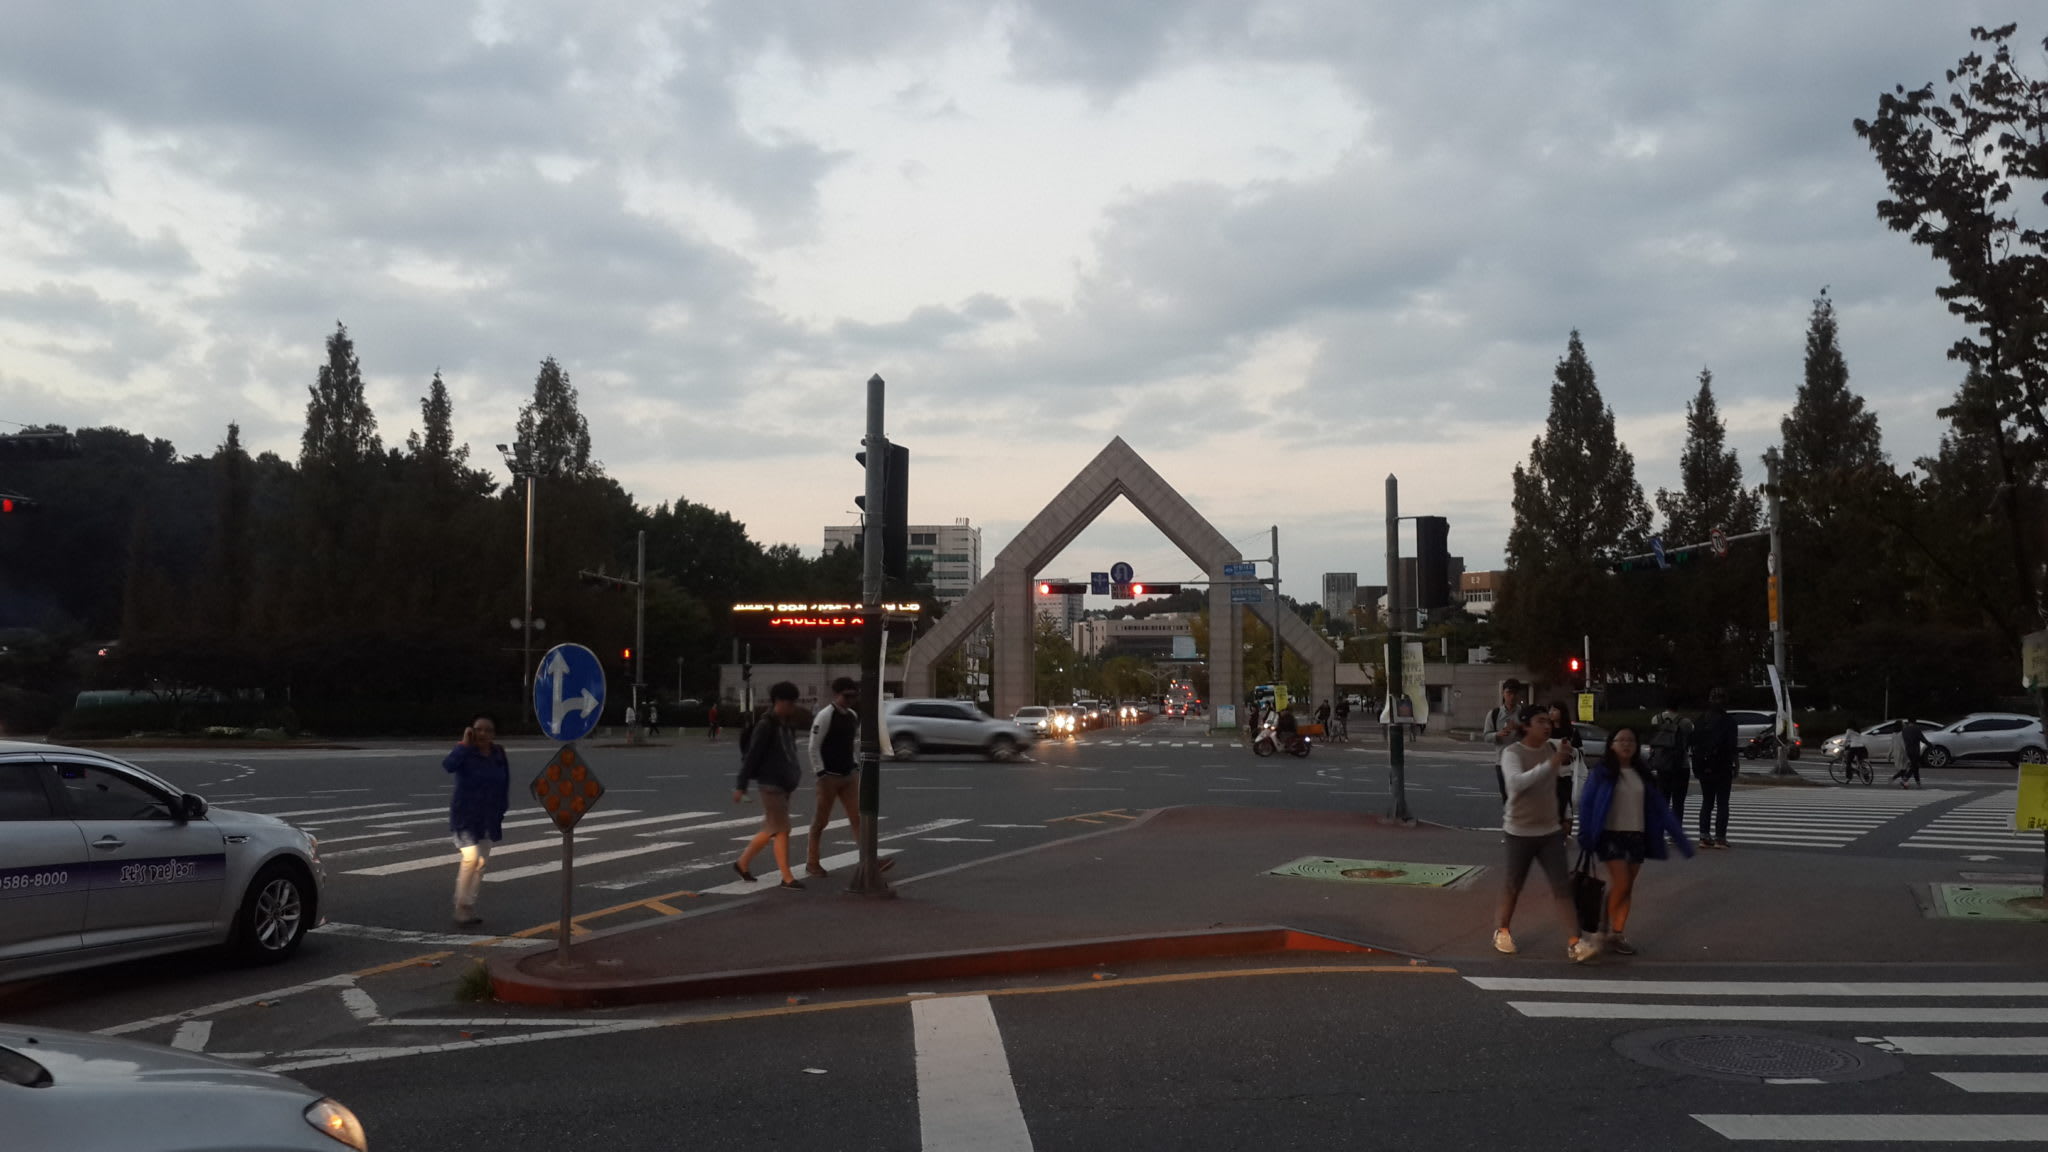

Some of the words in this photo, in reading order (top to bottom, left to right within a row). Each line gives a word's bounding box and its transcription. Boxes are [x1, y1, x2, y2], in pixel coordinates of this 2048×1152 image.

[0, 871, 68, 889] 586-8000
[120, 863, 146, 884] It's
[149, 858, 196, 882] Daejeon
